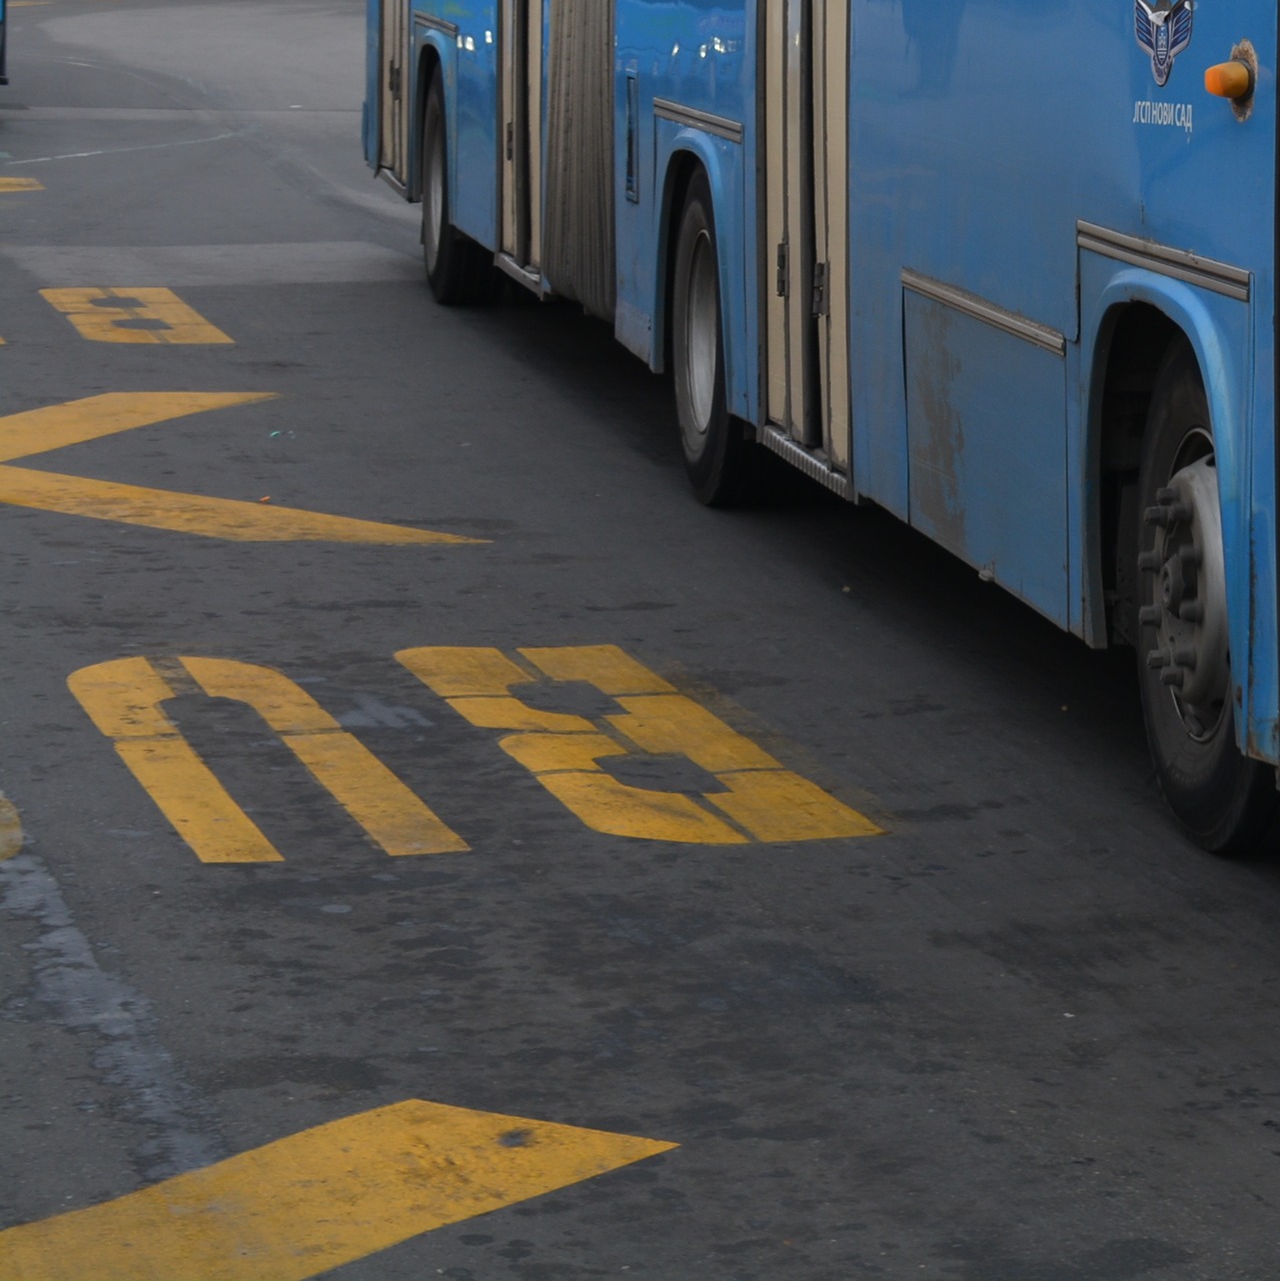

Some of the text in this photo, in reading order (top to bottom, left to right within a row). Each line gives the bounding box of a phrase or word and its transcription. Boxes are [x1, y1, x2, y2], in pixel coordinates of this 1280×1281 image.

[1152, 101, 1175, 127] НОВИ
[1175, 103, 1193, 133] САД
[0, 643, 887, 864] BU
